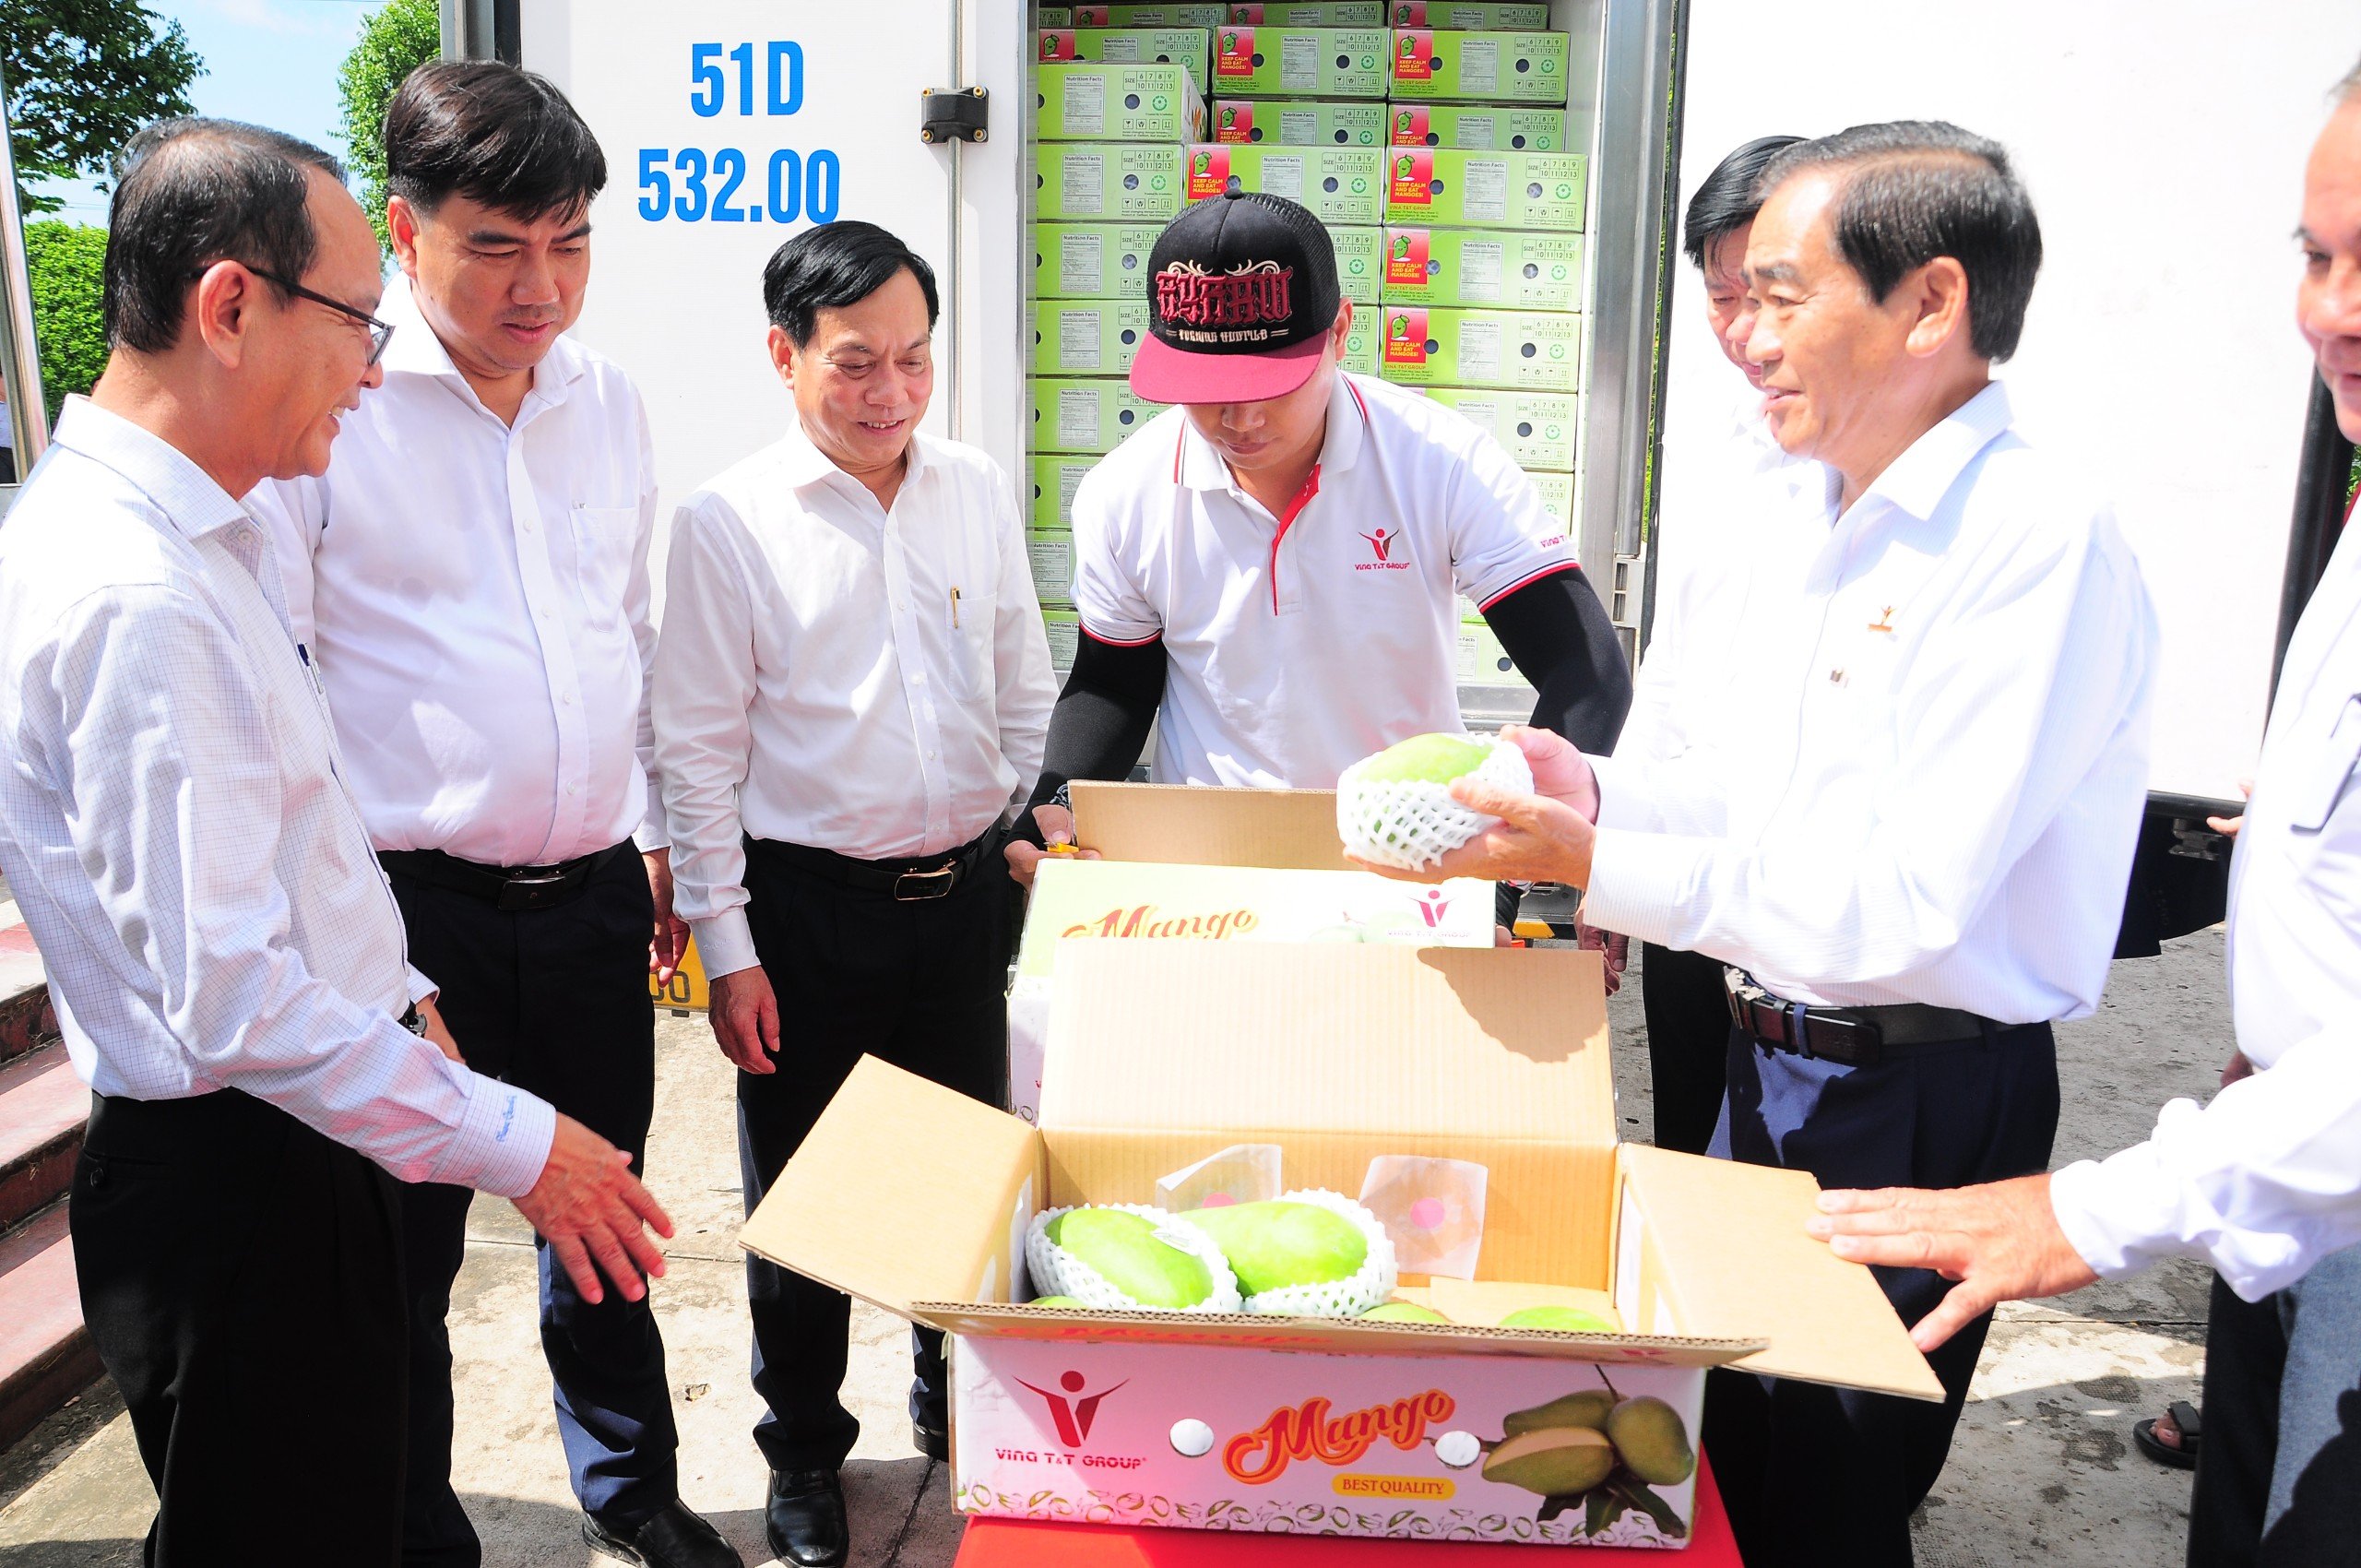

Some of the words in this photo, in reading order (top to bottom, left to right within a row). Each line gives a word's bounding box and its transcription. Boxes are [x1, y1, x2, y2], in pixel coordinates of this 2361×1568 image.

[691, 42, 803, 117] 51D
[638, 148, 840, 224] 532.00
[1082, 1455, 1142, 1470] GROUP
[1223, 1388, 1454, 1484] Mango
[1343, 1478, 1379, 1493] BEST
[1379, 1479, 1445, 1496] QUALITY
